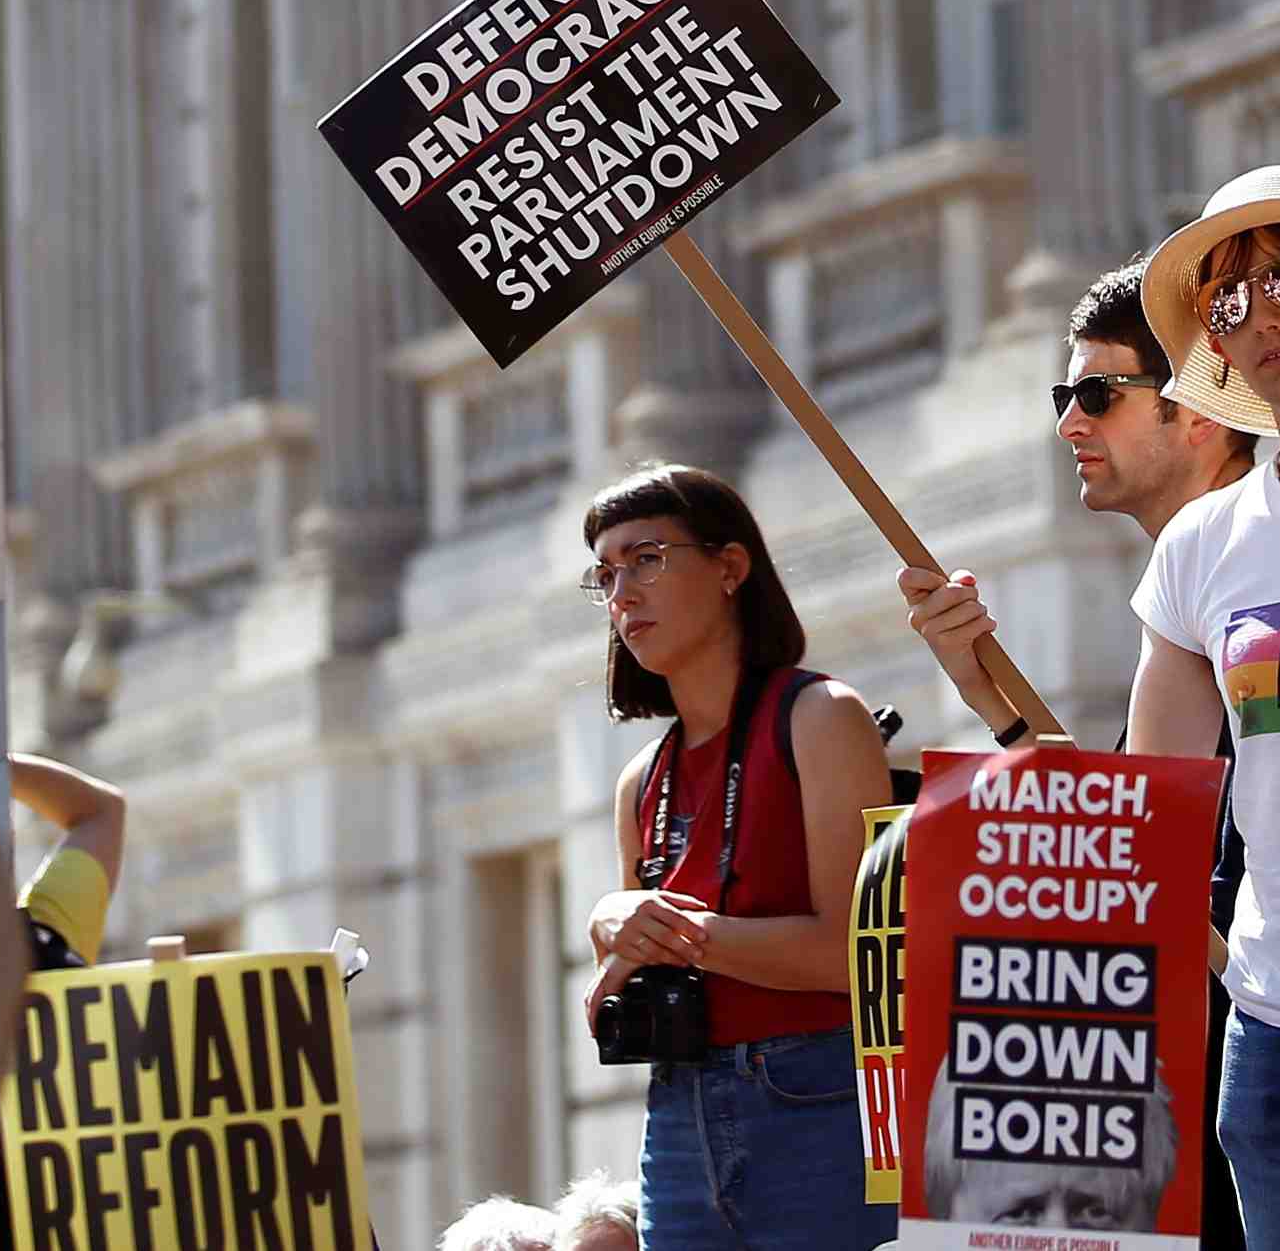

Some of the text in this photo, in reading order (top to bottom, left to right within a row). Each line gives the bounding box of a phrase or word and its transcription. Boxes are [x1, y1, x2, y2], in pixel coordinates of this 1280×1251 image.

[447, 6, 709, 226] RESIST THE
[458, 27, 757, 280] PARLIAMENT
[496, 73, 782, 311] SHUTDOWN
[601, 174, 724, 275] ANOTHER EUROPE IS POSSIBLE
[724, 762, 741, 829] Canon
[970, 770, 1153, 820] MARCH,
[977, 823, 1141, 876] STRIKE,
[959, 876, 1157, 924] OCCUPY
[959, 946, 1148, 1006] BRING
[19, 965, 339, 1132] REMAIN
[956, 1023, 1147, 1084] DOWN
[962, 1097, 1136, 1159] BORIS
[23, 1113, 355, 1251] REFORM
